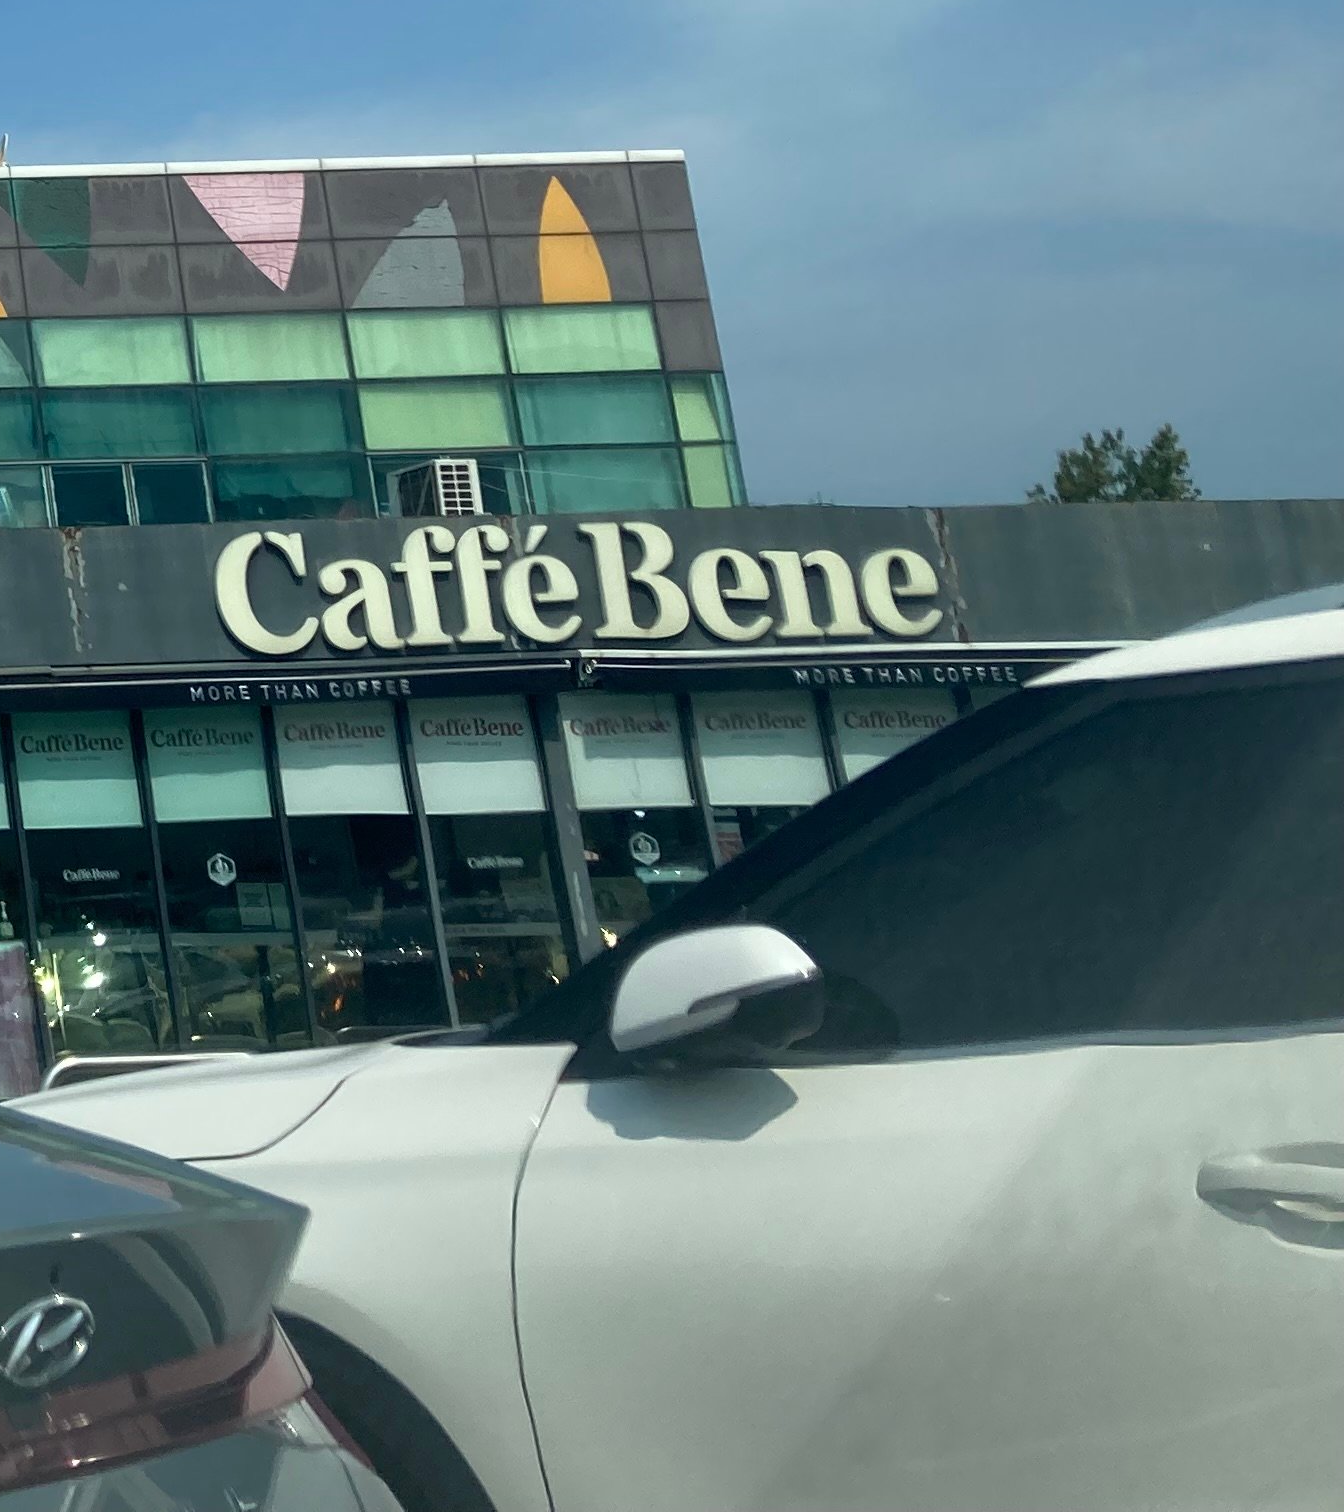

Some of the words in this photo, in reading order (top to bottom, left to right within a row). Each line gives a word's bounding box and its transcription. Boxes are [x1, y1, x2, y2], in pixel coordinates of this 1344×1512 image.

[214, 523, 583, 656] Caffé
[576, 521, 946, 642] Bene
[792, 667, 857, 685] MORE
[863, 667, 923, 684] THAN
[933, 665, 1017, 683] COFFEE
[189, 685, 252, 702] MORE
[259, 683, 320, 700] THAN
[328, 678, 412, 698] COFFEE
